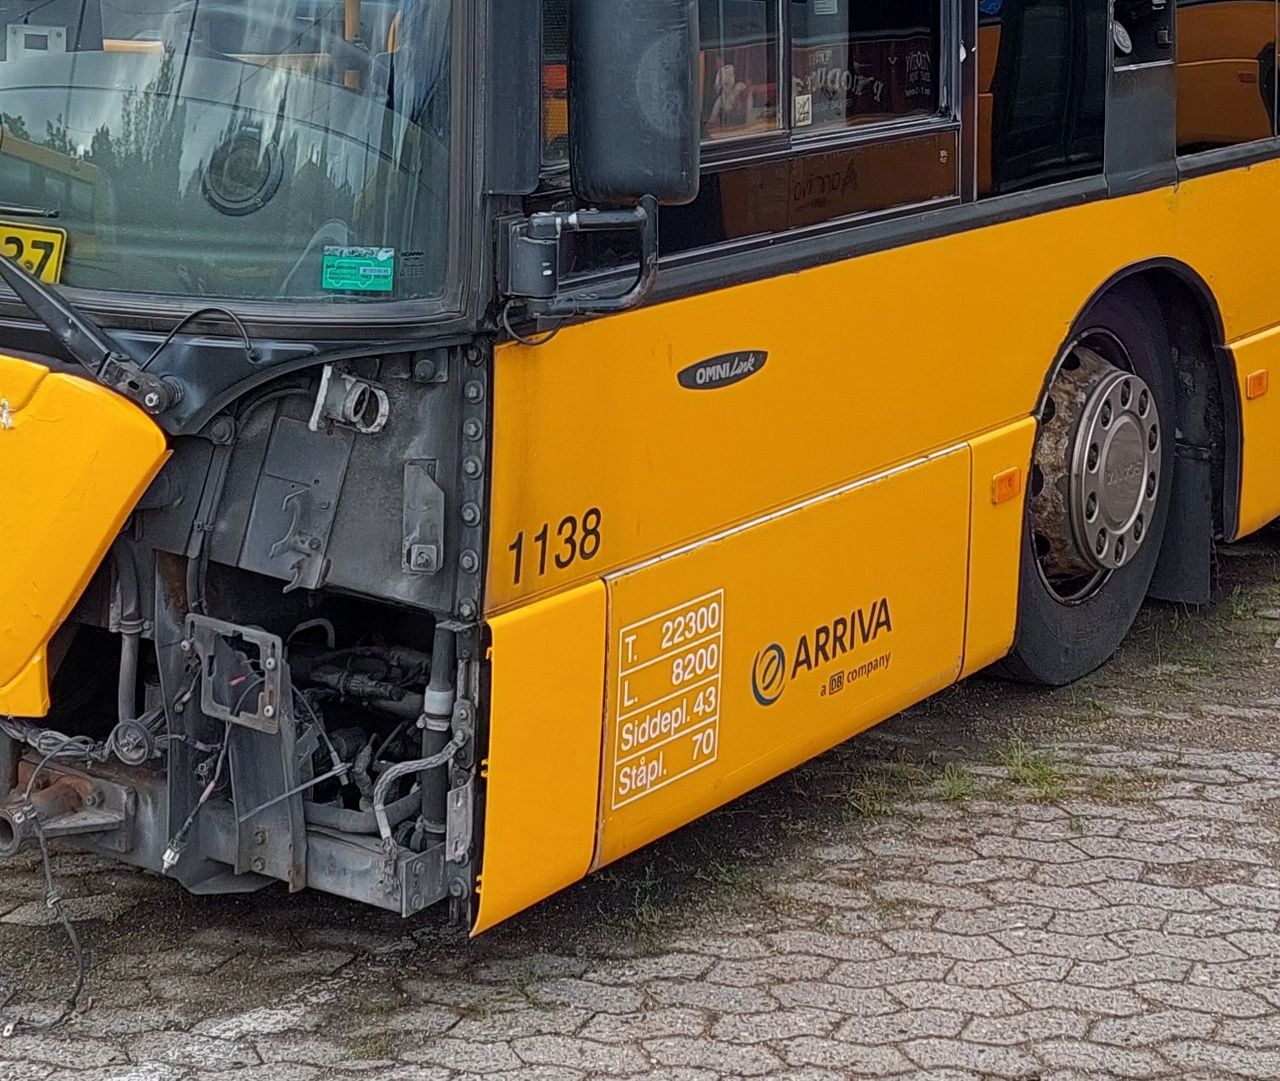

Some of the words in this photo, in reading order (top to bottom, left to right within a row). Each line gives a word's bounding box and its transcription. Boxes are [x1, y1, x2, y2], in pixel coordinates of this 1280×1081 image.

[509, 507, 602, 585] 1138
[624, 634, 638, 664] T.
[661, 602, 719, 649] 22300
[791, 597, 892, 680] ARRIVA
[623, 680, 639, 707] L.
[672, 643, 718, 686] 8200
[820, 684, 827, 697] a
[829, 672, 844, 694] DB
[847, 652, 892, 684] company
[621, 698, 690, 752] Siddepl.
[693, 686, 716, 717] 43
[618, 751, 667, 796] Ståpl.
[691, 728, 714, 761] 70
